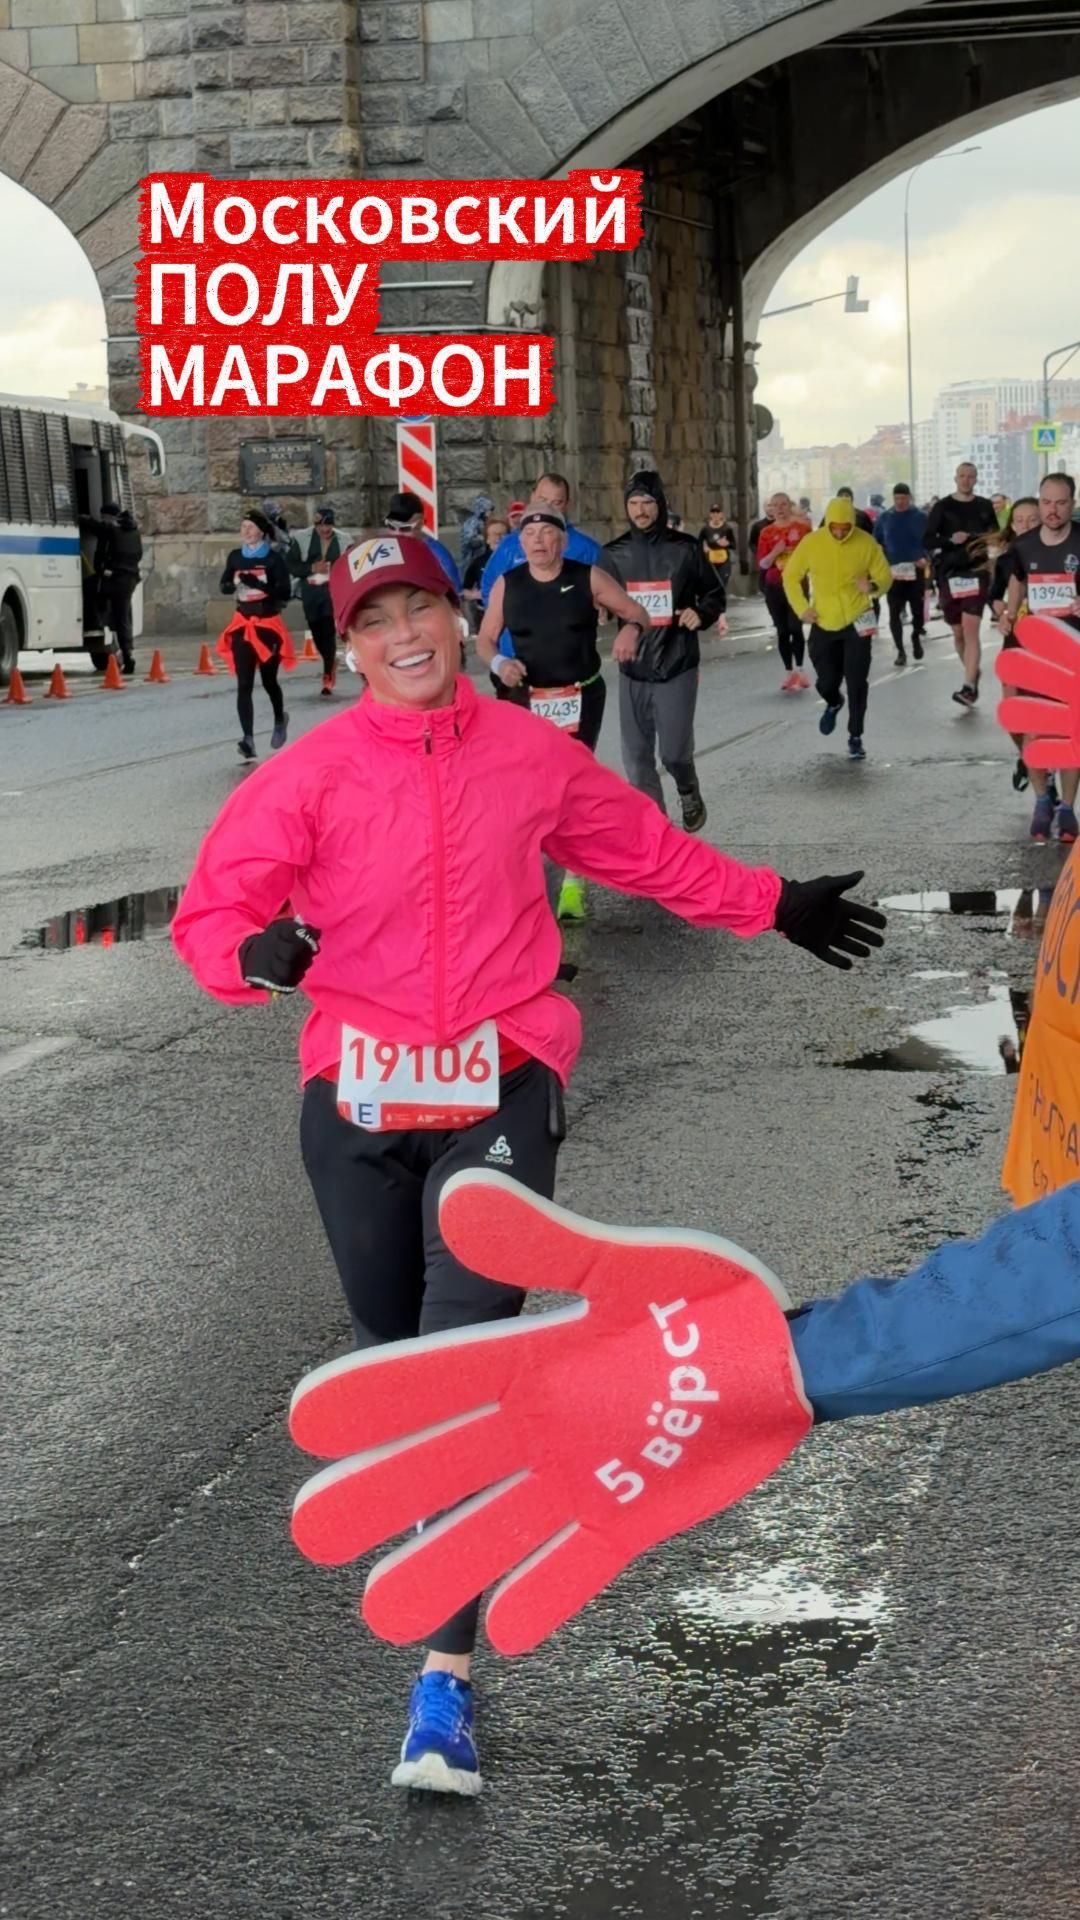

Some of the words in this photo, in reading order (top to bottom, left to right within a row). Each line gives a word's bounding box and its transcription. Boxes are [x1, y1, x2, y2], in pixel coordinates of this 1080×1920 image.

[533, 699, 580, 718] 12435
[348, 1036, 492, 1084] 19106
[594, 1457, 645, 1505] 5
[640, 1297, 720, 1469] вёрст
